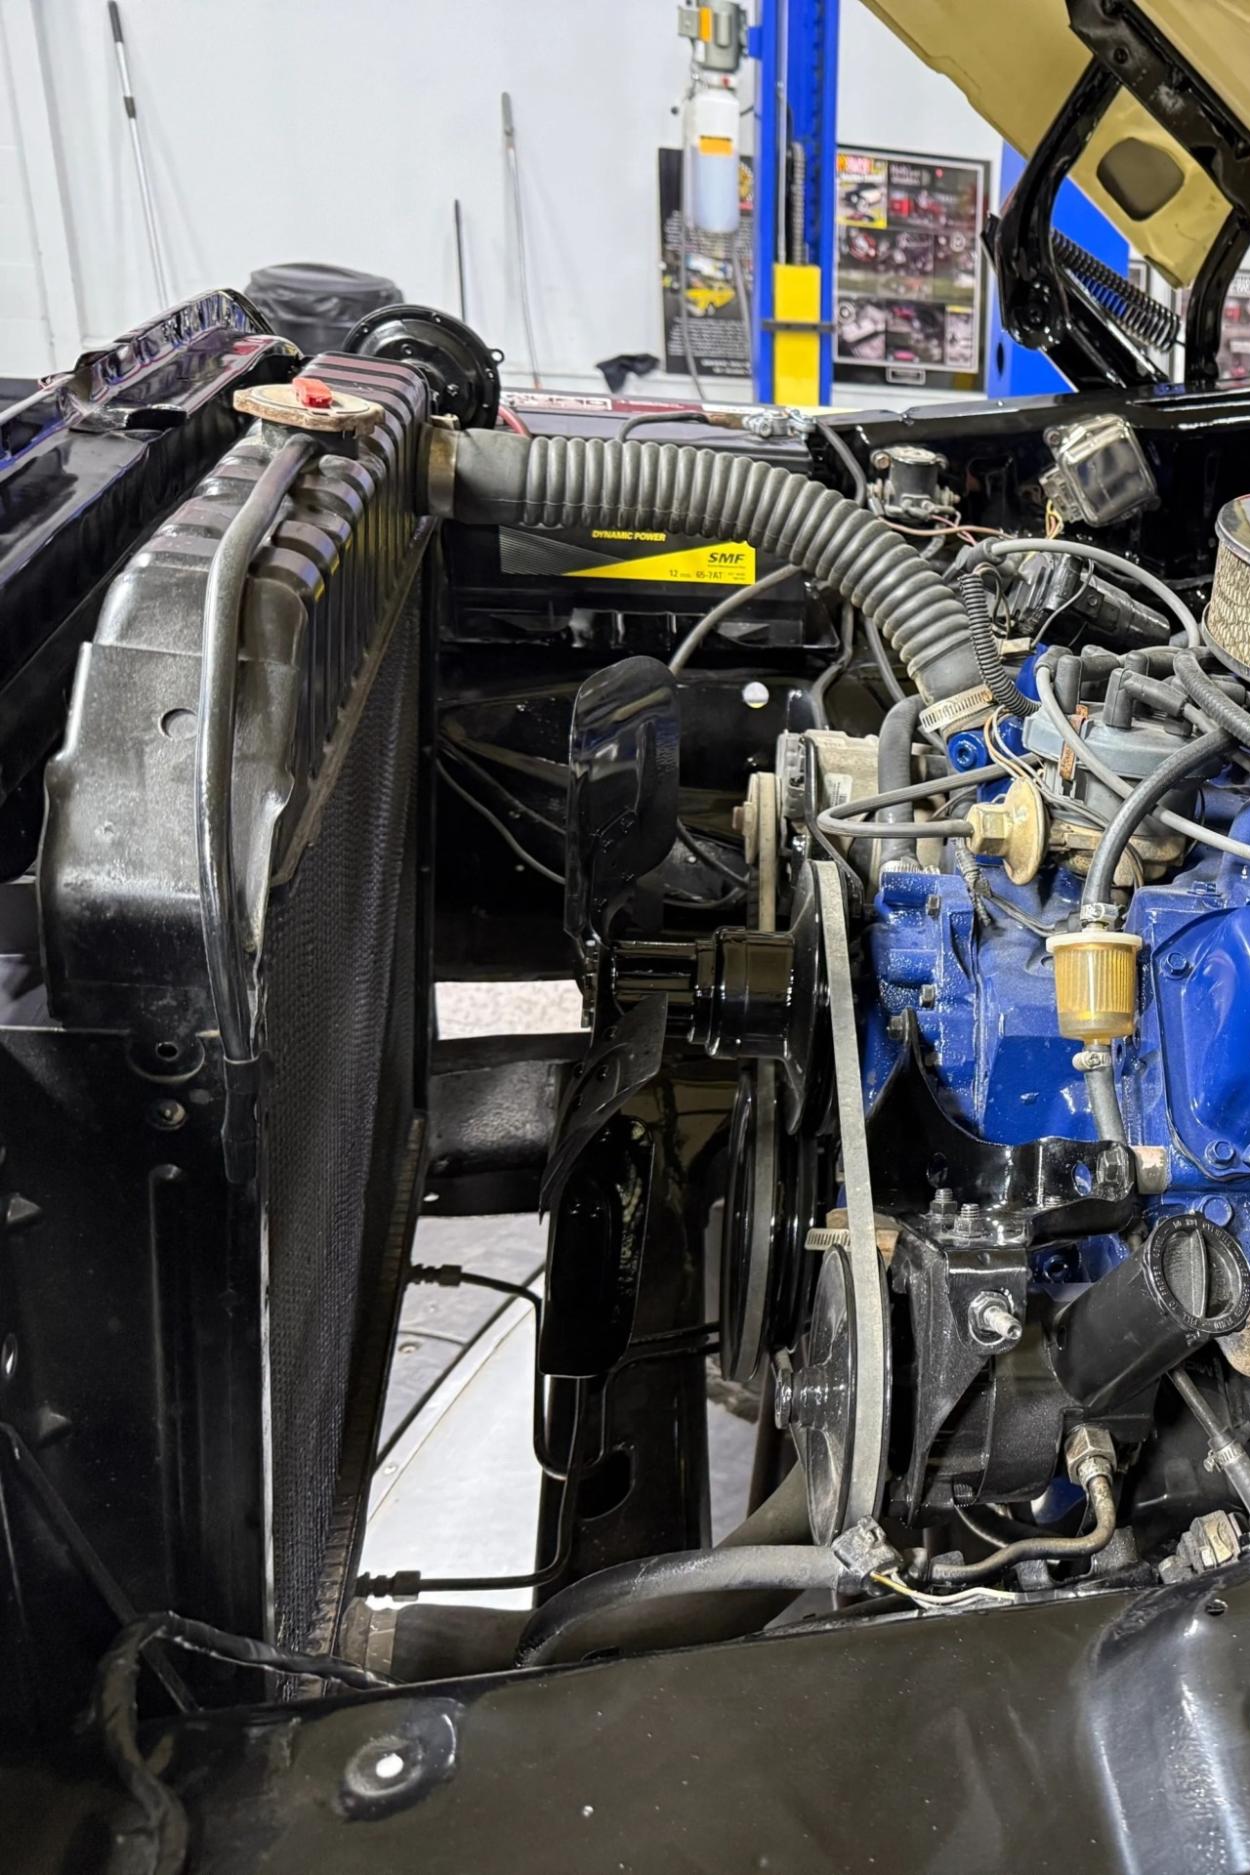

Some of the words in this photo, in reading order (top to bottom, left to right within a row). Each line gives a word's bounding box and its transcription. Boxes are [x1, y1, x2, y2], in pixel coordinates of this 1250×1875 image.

[592, 530, 633, 540] DYNAMIC
[634, 532, 666, 542] POWER
[708, 552, 745, 564] SMF
[669, 569, 679, 578] 12
